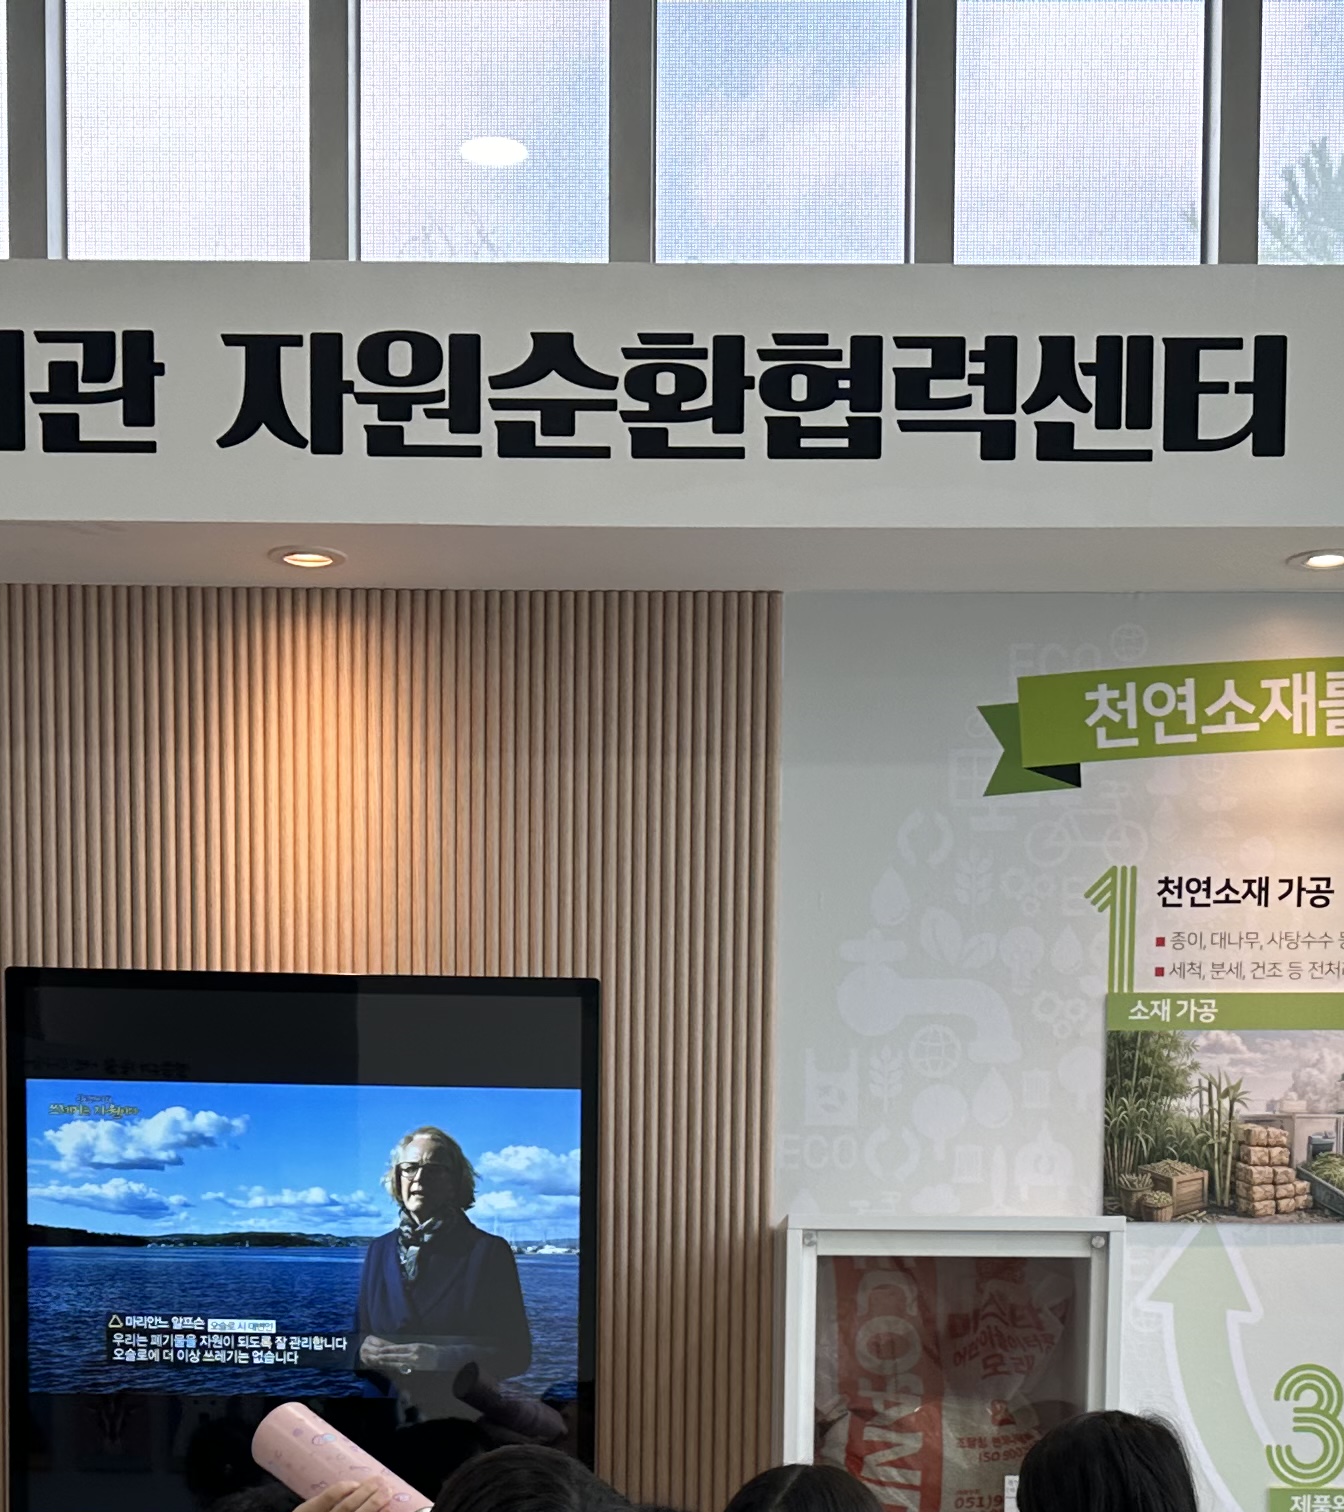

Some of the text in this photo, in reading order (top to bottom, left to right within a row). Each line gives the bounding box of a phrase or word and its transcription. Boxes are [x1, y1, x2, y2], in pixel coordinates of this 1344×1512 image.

[212, 327, 1290, 465] 자원순환협력센터
[1157, 876, 1334, 908] 천연소재 가공
[1084, 866, 1137, 993] 1
[1171, 932, 1206, 950] 종이,
[1211, 931, 1263, 950] 대나무,
[1267, 931, 1334, 950] 사탕수수
[1169, 962, 1205, 980] 세척,
[1210, 961, 1245, 980] 분세,
[1251, 961, 1283, 979] 건조
[1288, 962, 1303, 980] 등
[1129, 999, 1218, 1023] 소재 가공
[113, 1333, 148, 1349] 우리는
[200, 1334, 234, 1348] 자원이
[238, 1336, 272, 1349] 되도록
[275, 1336, 287, 1349] 잘
[289, 1336, 347, 1350] 관리합니다
[113, 1348, 298, 1364] 오슬로에 더 이상 쓰레기는 없습니다
